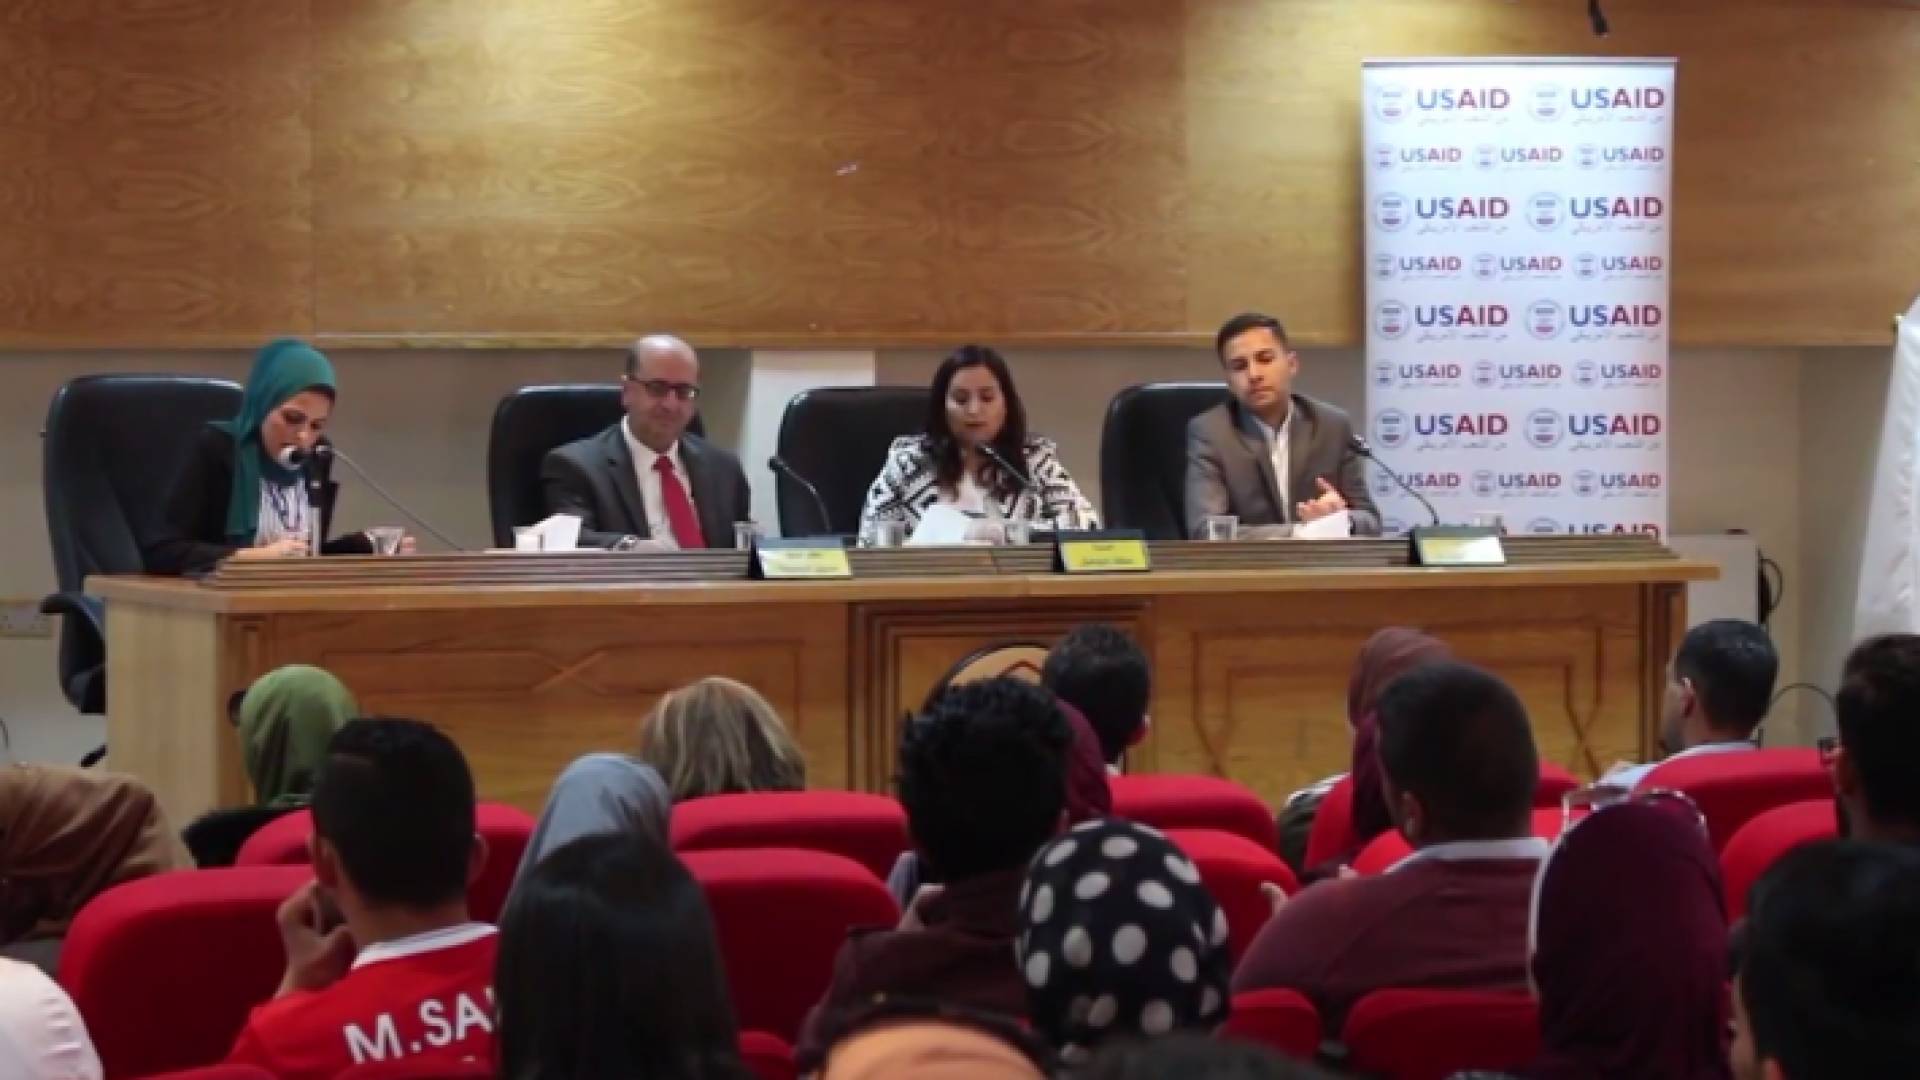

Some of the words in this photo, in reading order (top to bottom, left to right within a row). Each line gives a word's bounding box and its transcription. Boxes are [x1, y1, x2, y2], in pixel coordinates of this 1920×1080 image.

[1417, 88, 1511, 109] USAID
[1571, 88, 1665, 109] USAID
[1400, 148, 1462, 162] USAID
[1501, 148, 1563, 162] USAID
[1603, 148, 1664, 162] USAID
[1415, 197, 1510, 219] USAID
[1570, 197, 1664, 219] USAID
[1400, 256, 1461, 271] USAID
[1500, 256, 1562, 271] USAID
[1601, 256, 1662, 271] USAID
[1415, 305, 1509, 327] USAID
[1569, 305, 1662, 327] USAID
[1399, 364, 1461, 379] USAID
[1500, 364, 1561, 379] USAID
[1601, 364, 1661, 379] USAID
[1415, 414, 1508, 436] USAID
[1568, 414, 1661, 436] USAID
[1399, 473, 1461, 488] USAID
[1499, 473, 1561, 488] USAID
[1601, 473, 1661, 488] USAID
